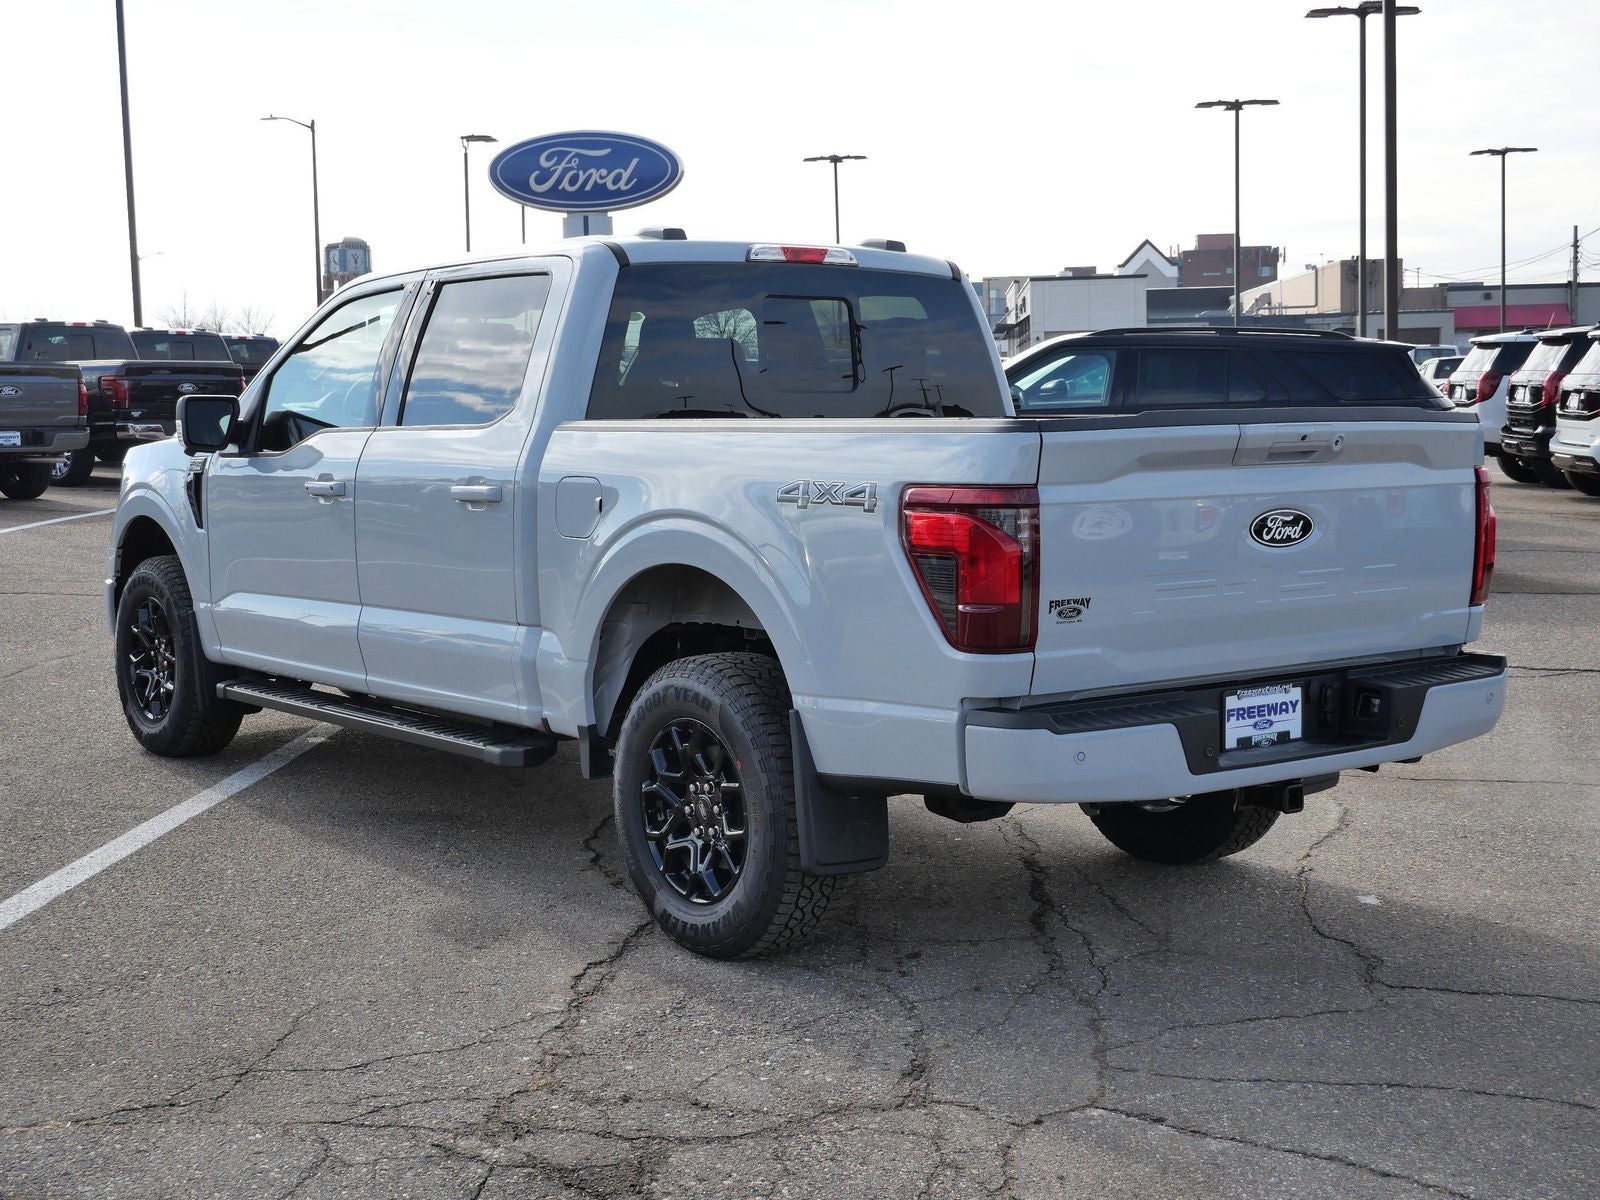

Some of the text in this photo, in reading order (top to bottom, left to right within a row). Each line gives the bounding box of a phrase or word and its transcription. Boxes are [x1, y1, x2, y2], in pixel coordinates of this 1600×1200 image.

[528, 146, 640, 193] Ford
[1262, 515, 1304, 541] Ford
[1048, 596, 1092, 615] FREEWAY
[1227, 699, 1299, 722] FREEWAY
[1256, 720, 1270, 729] Ford
